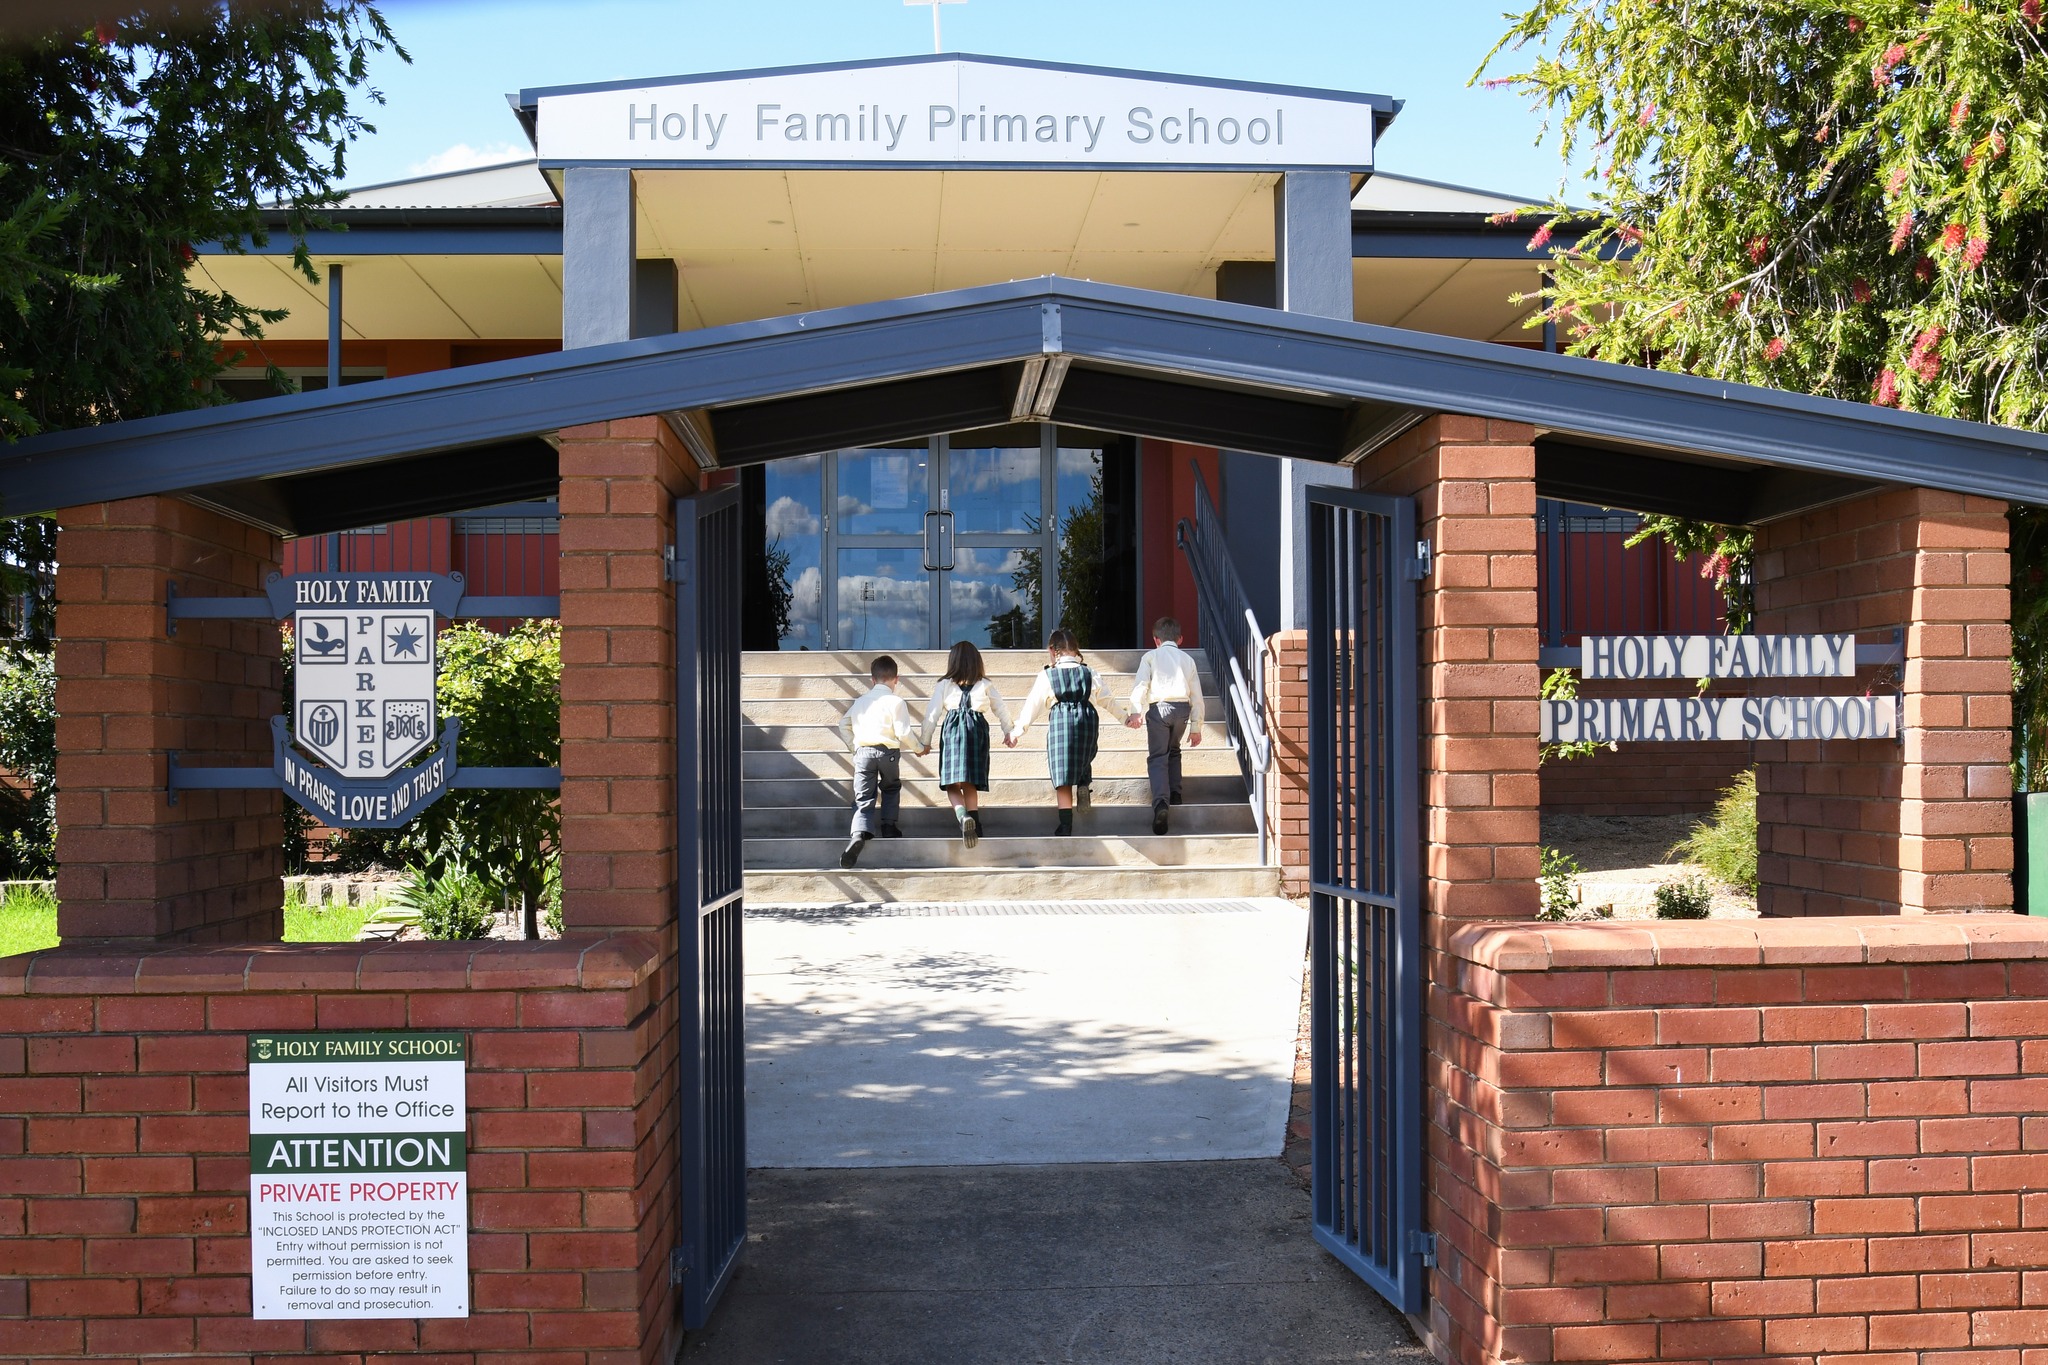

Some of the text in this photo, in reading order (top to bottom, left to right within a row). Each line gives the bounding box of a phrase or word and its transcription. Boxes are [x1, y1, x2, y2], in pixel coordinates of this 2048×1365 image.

[629, 103, 1283, 153] Holy Family Primary School
[295, 579, 433, 604] HOLY FAMILY
[1588, 633, 1851, 681] HOLY FAMILY
[354, 615, 377, 770] PARKES
[1548, 695, 1890, 743] PRIMARY SCHOOL
[284, 756, 446, 822] IN PRAISE LOVE AND TRUST
[276, 1039, 457, 1057] HOLY FAMILY SCHOOL
[285, 1074, 430, 1094] All Visitors Must
[261, 1100, 455, 1123] Report to the Office
[266, 1138, 450, 1168] ATTENTION
[260, 1181, 459, 1203] PRIVATE PROPERTY
[272, 1209, 446, 1223] This School is protected by the
[321, 1225, 358, 1236] LANDS
[361, 1224, 431, 1236] PROTECTION
[276, 1239, 444, 1254] Entry without permission is not
[266, 1253, 454, 1269] permitted. You are asked to seek
[292, 1269, 428, 1283] permission before entry.
[279, 1283, 442, 1297] Failure to do so may result in
[287, 1298, 434, 1312] removal and prosecution.
